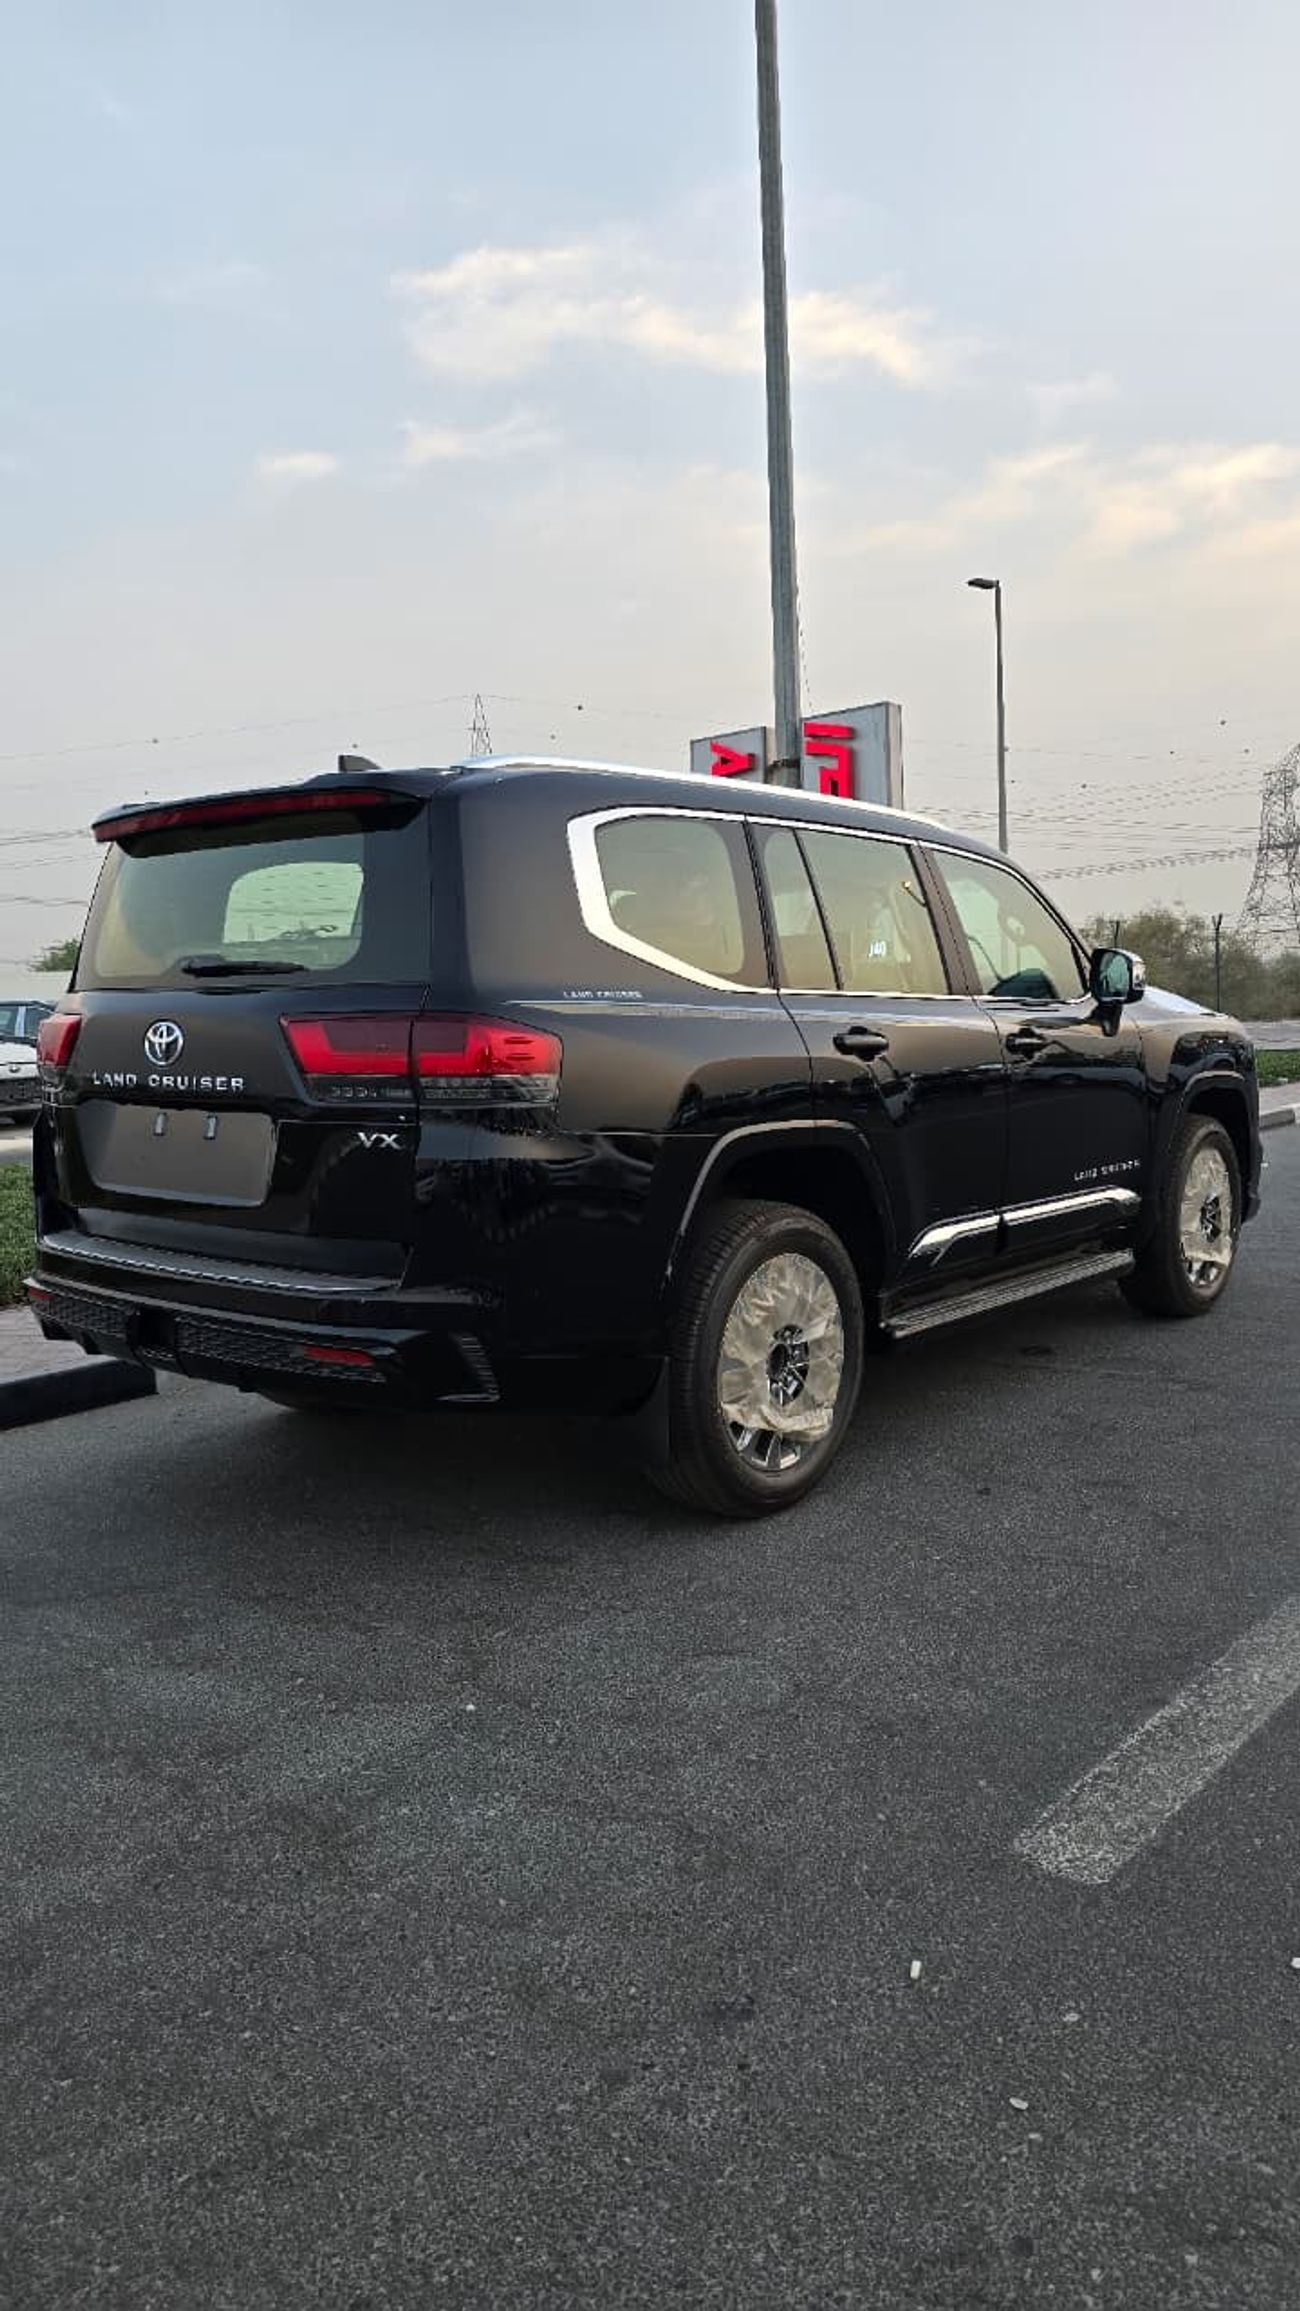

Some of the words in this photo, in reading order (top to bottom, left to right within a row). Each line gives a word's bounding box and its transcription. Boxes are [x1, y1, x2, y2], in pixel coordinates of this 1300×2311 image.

[92, 1072, 138, 1087] LAND
[148, 1074, 244, 1092] CRUISER
[357, 1131, 402, 1150] VX
